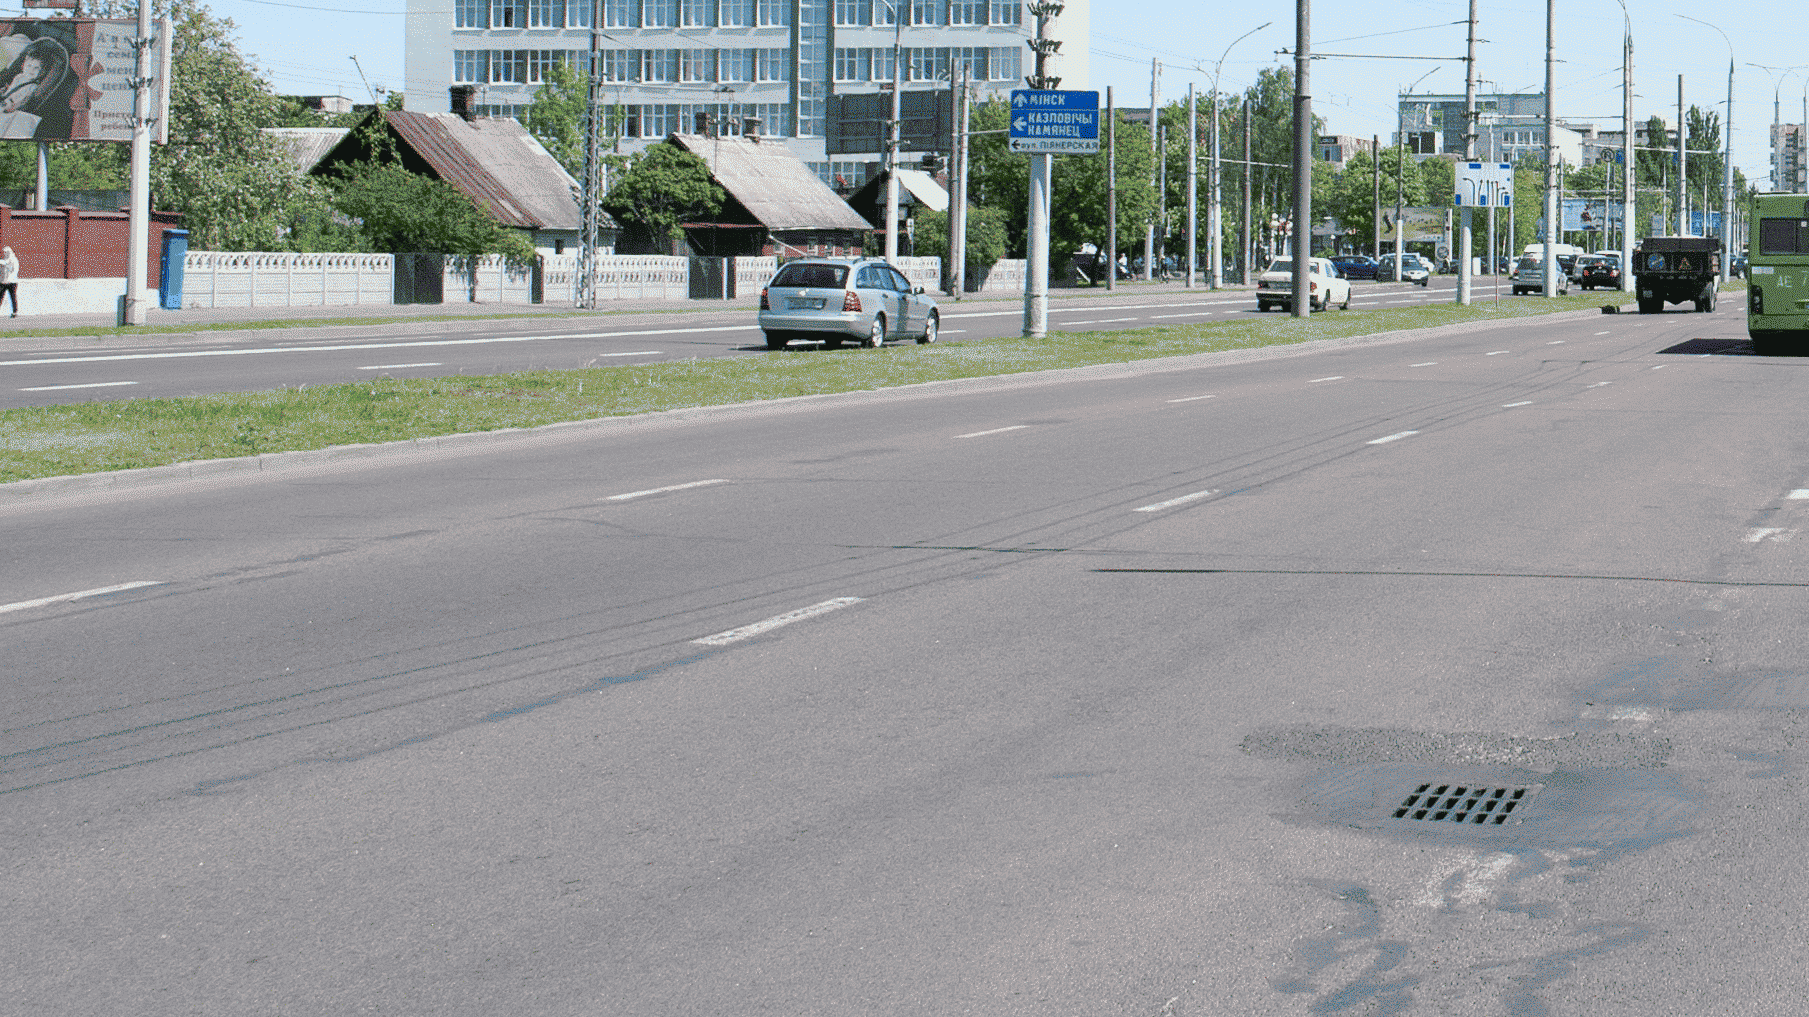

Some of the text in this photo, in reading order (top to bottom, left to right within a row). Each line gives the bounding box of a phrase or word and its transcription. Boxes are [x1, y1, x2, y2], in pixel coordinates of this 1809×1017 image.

[1029, 94, 1066, 106] МІНСК
[94, 110, 131, 120] Присте
[1028, 112, 1093, 124] КАЗЛОВІЧЫ
[1028, 125, 1081, 138] КАМЯНЕЦ
